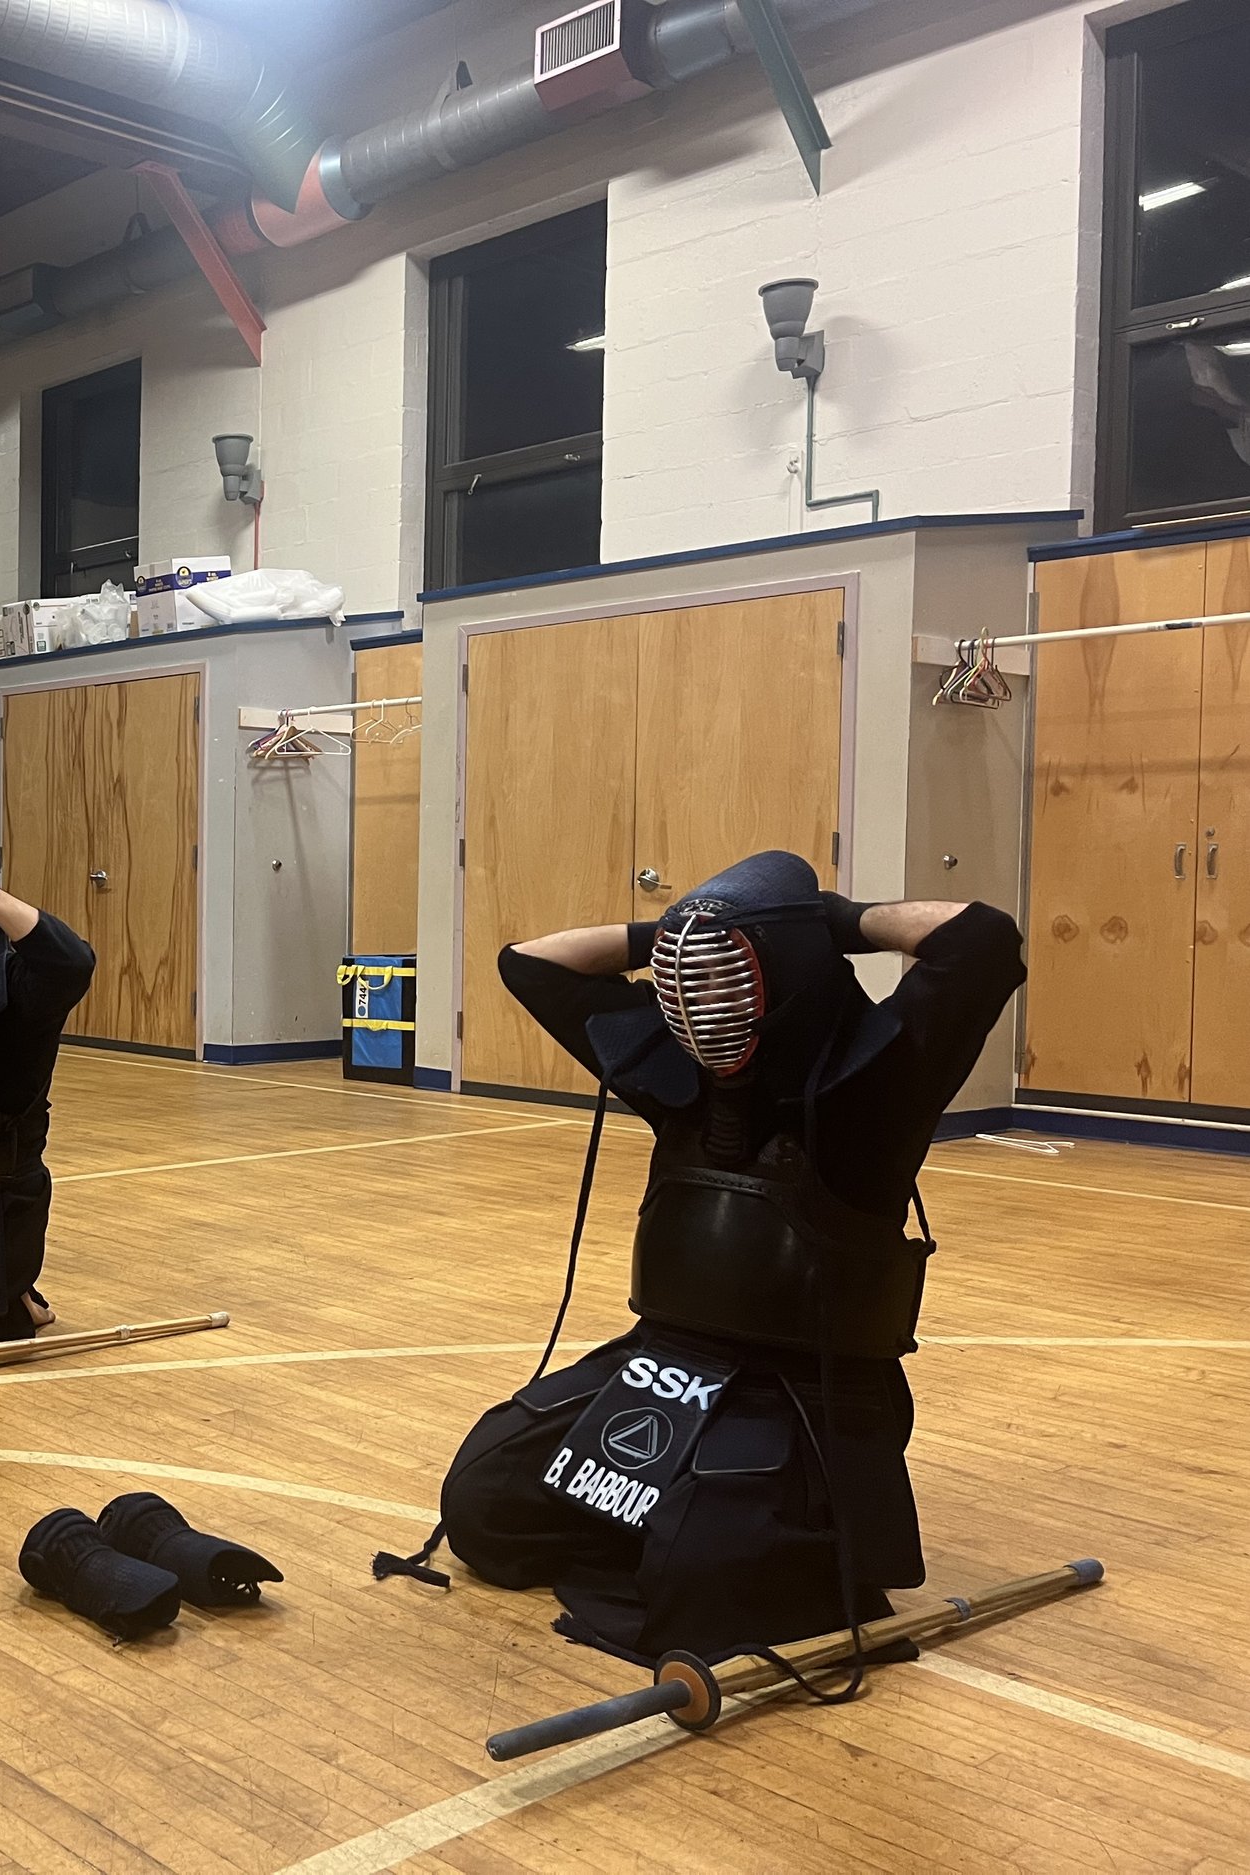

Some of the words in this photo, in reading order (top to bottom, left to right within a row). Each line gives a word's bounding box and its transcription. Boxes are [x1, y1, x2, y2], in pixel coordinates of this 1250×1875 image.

[359, 984, 367, 1005] 744
[621, 1357, 723, 1411] SSK
[543, 1447, 573, 1488] B.
